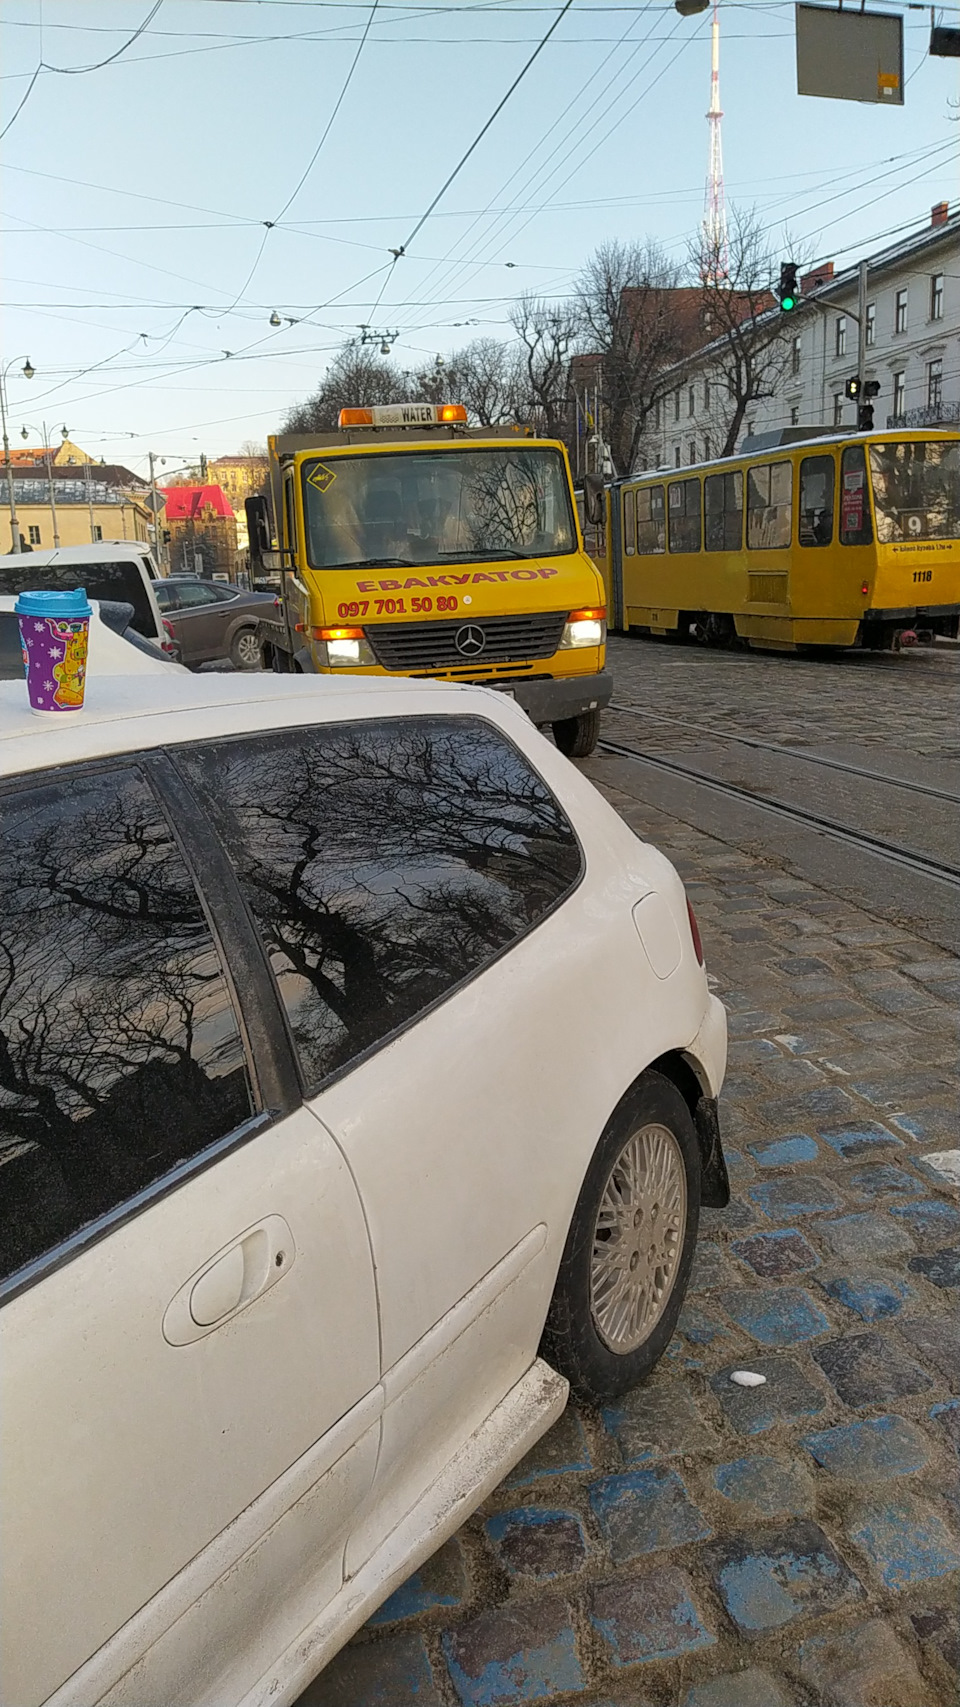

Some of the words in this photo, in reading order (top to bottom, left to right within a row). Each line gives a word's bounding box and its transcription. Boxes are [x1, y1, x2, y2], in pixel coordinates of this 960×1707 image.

[401, 407, 432, 422] WATER
[908, 516, 922, 536] 9
[356, 568, 558, 593] ЕВАКУАТОР
[912, 570, 932, 583] 1118
[338, 601, 369, 618] 097
[374, 598, 407, 614] 701
[411, 597, 432, 612] 50
[436, 596, 458, 611] 80
